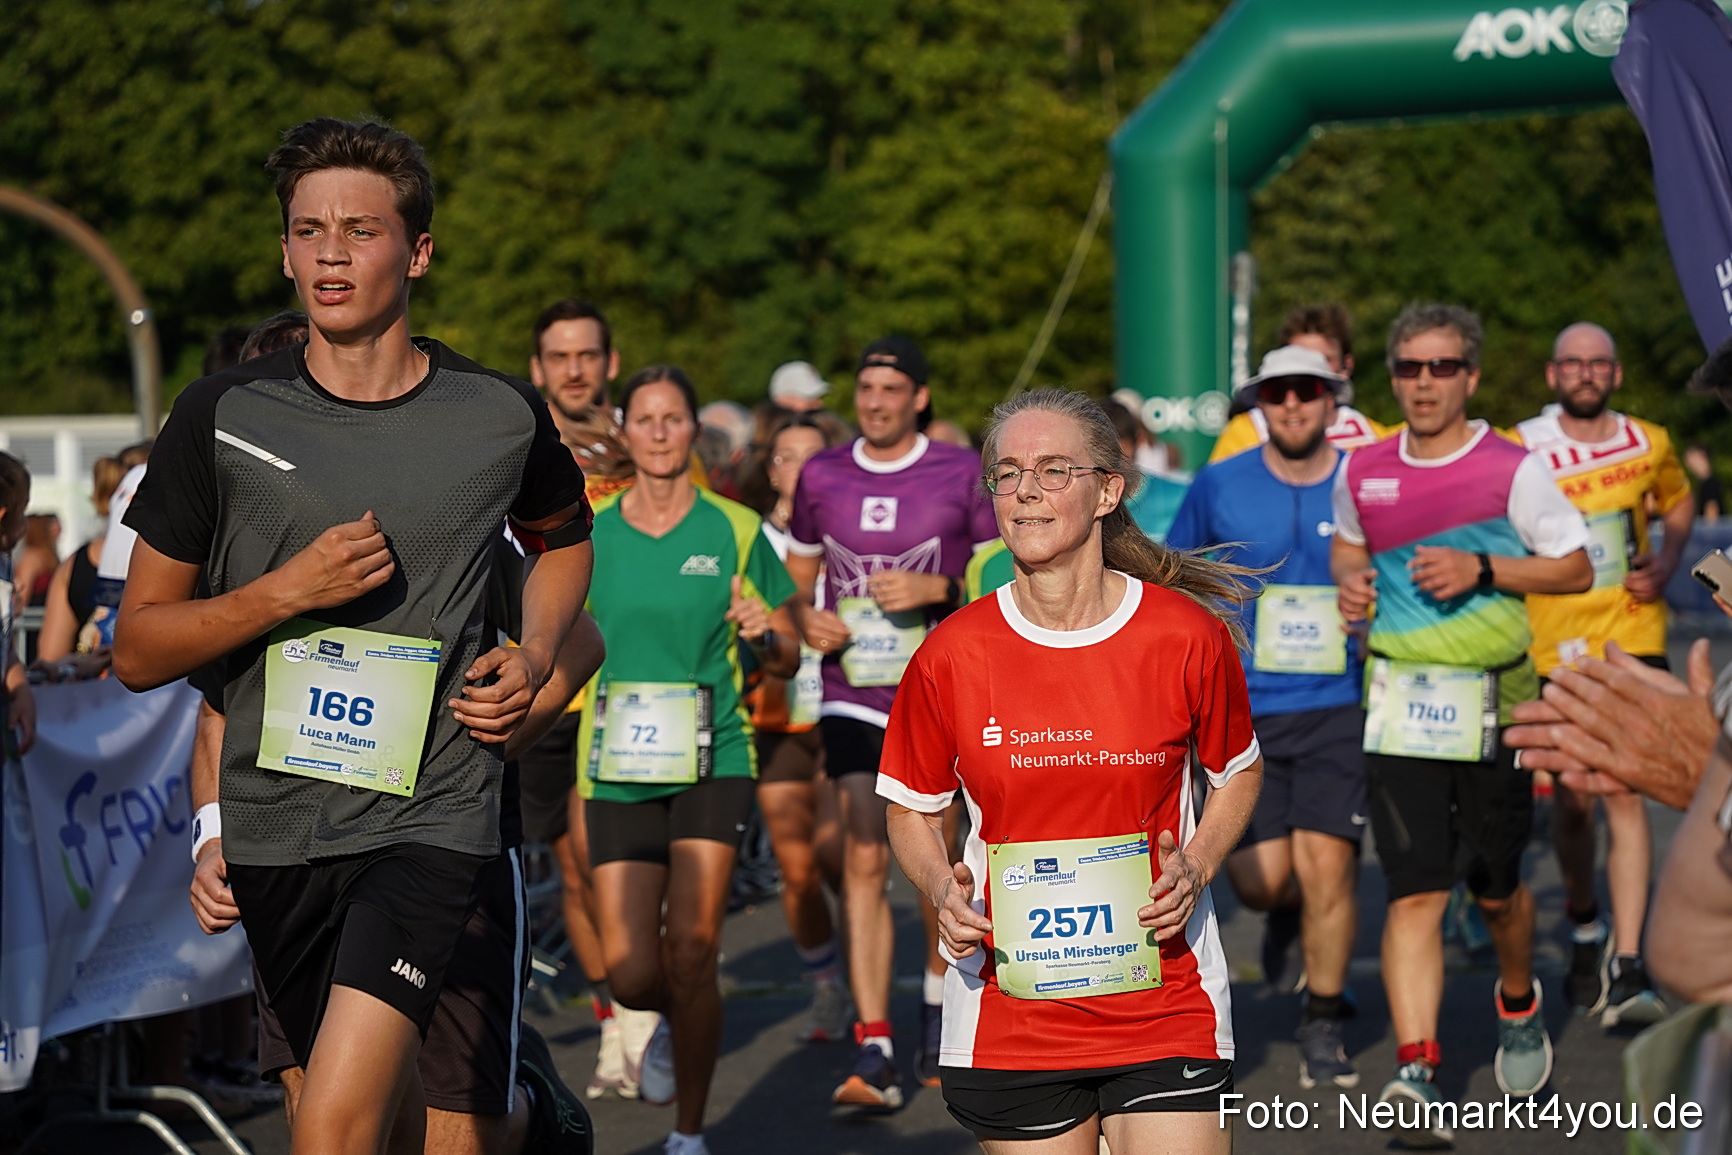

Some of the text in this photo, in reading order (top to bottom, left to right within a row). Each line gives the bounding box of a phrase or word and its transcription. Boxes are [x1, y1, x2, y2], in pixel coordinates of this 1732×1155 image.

[1453, 5, 1574, 62] AOK
[1141, 396, 1197, 434] OK
[680, 555, 720, 570] AOK
[1280, 622, 1321, 639] 955
[309, 652, 361, 669] Firmenlauf
[327, 663, 358, 674] neumarkt
[309, 686, 375, 727] 166
[1408, 702, 1457, 723] 1740
[299, 723, 377, 750] Luca Mann
[631, 725, 658, 744] 72
[1010, 727, 1093, 747] Sparkasse
[287, 757, 340, 772] firmenlauf.bayern
[1010, 749, 1166, 769] Neumarkt-Parsberg
[1028, 869, 1077, 884] Firmenlauf
[1047, 878, 1077, 887] neumarkt
[1028, 904, 1114, 940] 2571
[1015, 942, 1139, 963] Ursula Mirsberger
[1068, 959, 1112, 968] Neumarkt-Parsberg
[390, 957, 426, 990] JAKO
[1037, 979, 1088, 992] firmenlauf.bayern
